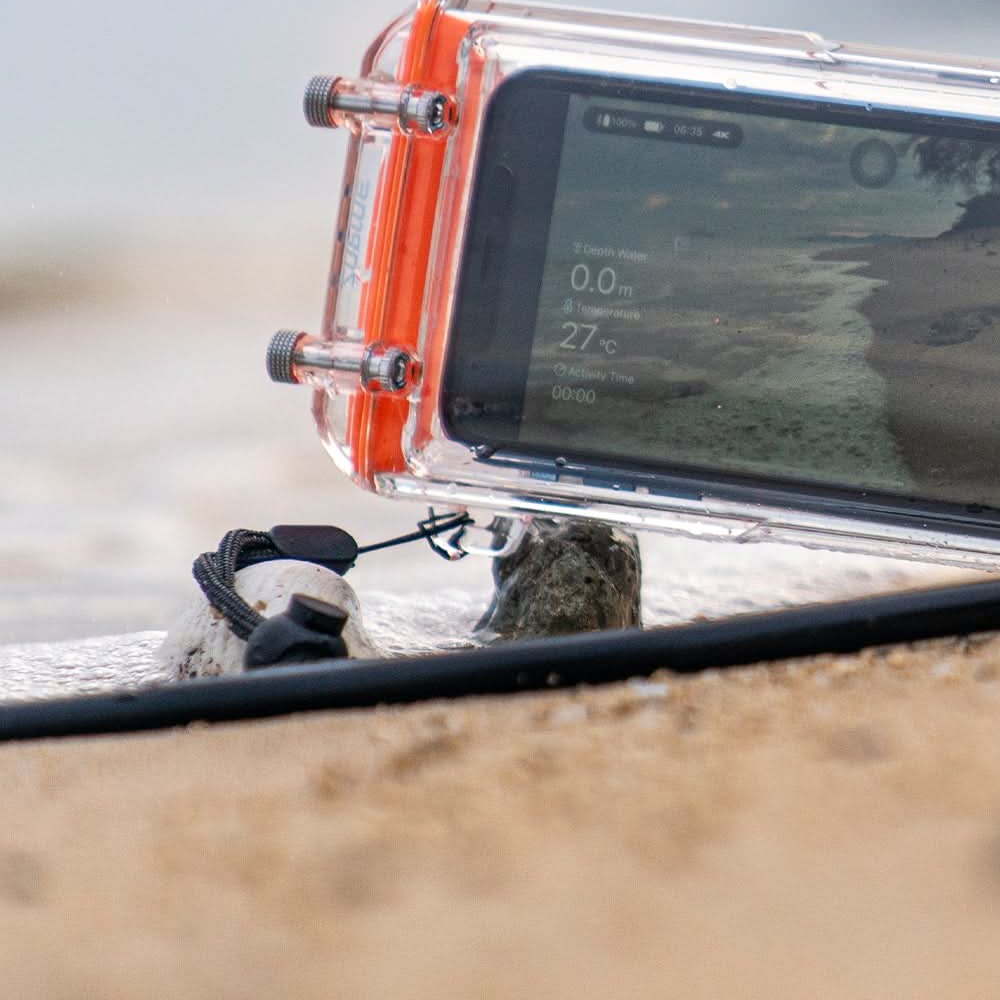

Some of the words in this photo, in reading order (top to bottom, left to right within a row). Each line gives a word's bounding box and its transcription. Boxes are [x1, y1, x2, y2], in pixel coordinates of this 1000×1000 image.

[571, 264, 616, 295] 0.0
[618, 284, 633, 297] m
[560, 321, 598, 351] 27
[599, 339, 617, 355] °C
[608, 371, 635, 385] Time
[551, 384, 597, 405] 00:00
